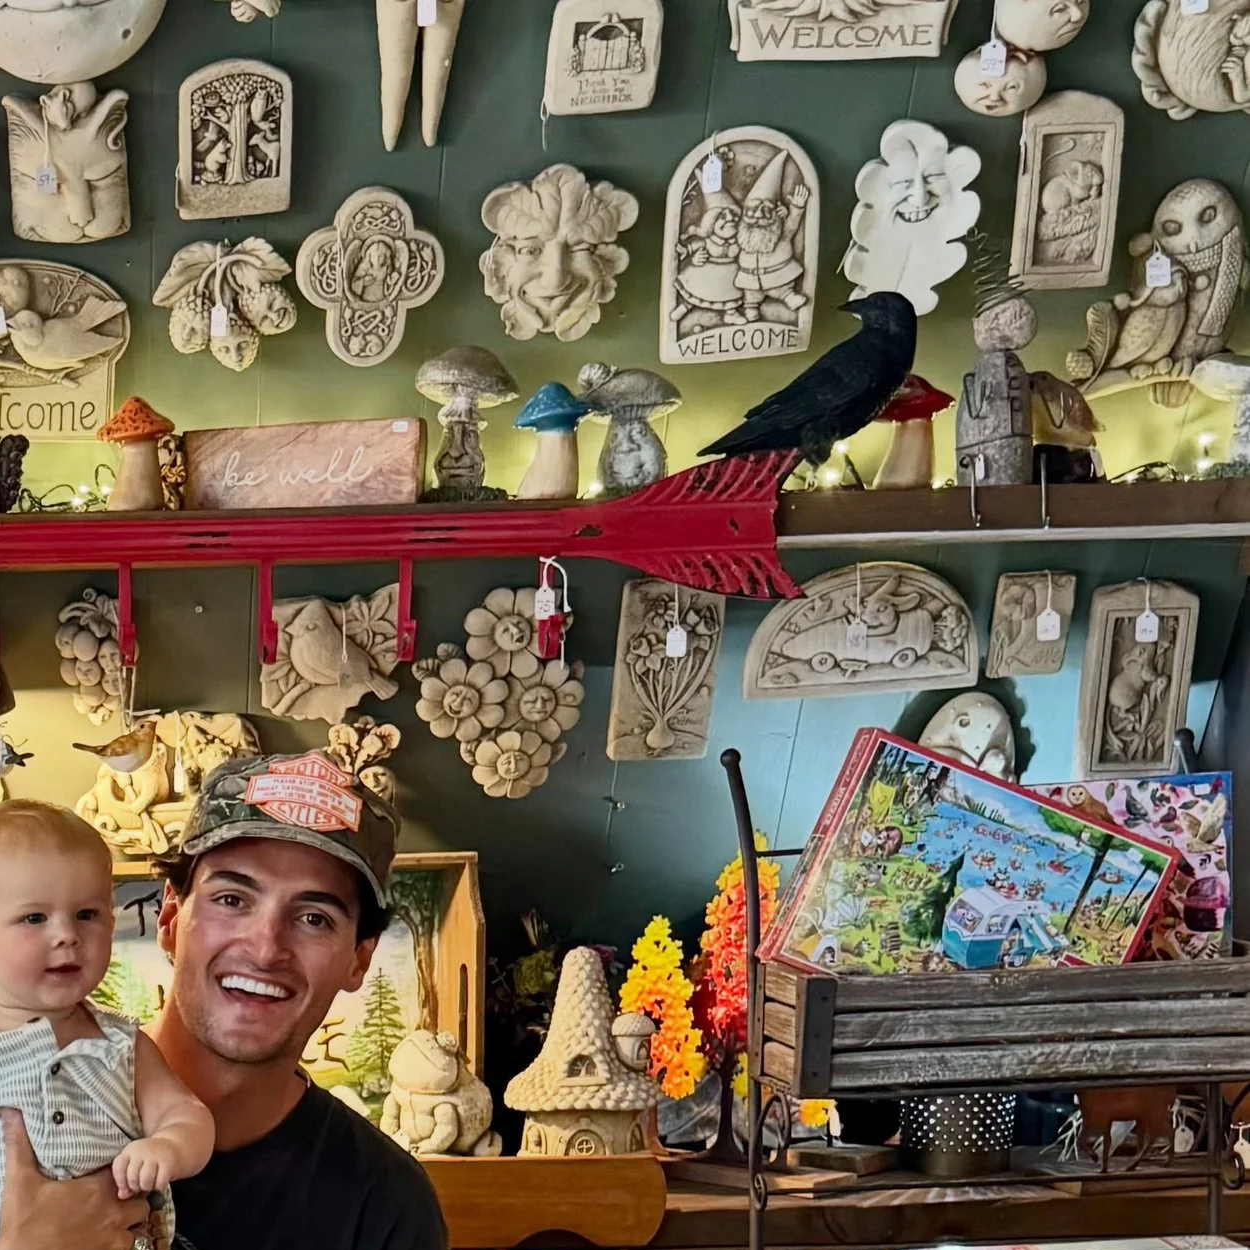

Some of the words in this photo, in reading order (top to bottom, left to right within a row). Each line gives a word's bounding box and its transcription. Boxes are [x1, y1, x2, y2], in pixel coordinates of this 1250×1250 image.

[749, 17, 933, 49] WELCOME
[677, 328, 799, 357] WELCOME
[221, 451, 268, 488] be
[277, 446, 373, 486] well
